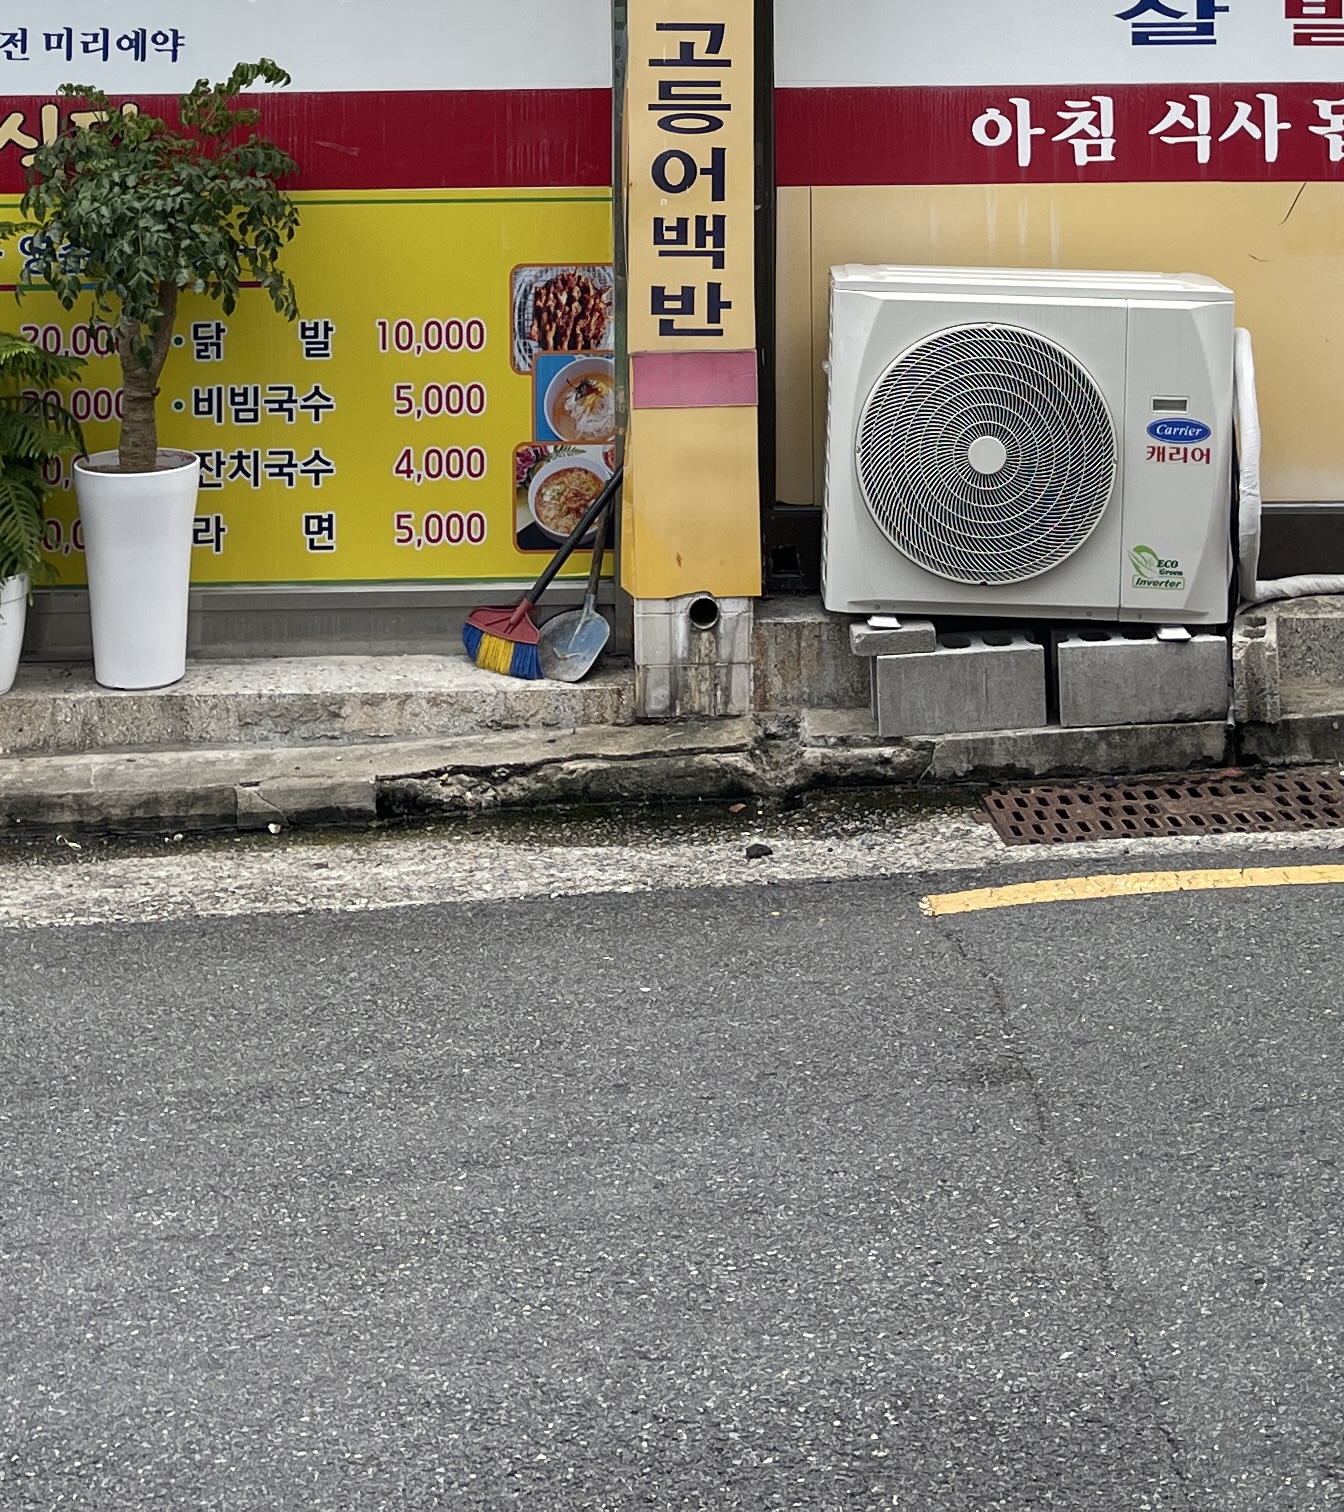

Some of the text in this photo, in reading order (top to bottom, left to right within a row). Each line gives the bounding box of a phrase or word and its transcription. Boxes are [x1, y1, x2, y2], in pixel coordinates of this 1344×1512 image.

[42, 26, 186, 63] 미리예약
[971, 96, 1117, 167] 아침
[1147, 92, 1292, 165] 식사
[648, 22, 732, 337] 고등어백반
[377, 319, 486, 356] 10,000
[192, 383, 486, 424] 비빔국수 5,000
[1156, 424, 1203, 437] Carrier
[198, 447, 486, 488] 잔치국수 4,000
[1146, 445, 1211, 465] 캐리어
[394, 512, 486, 549] 5,000
[1135, 577, 1182, 588] Inverter
[1157, 559, 1179, 569] ECO
